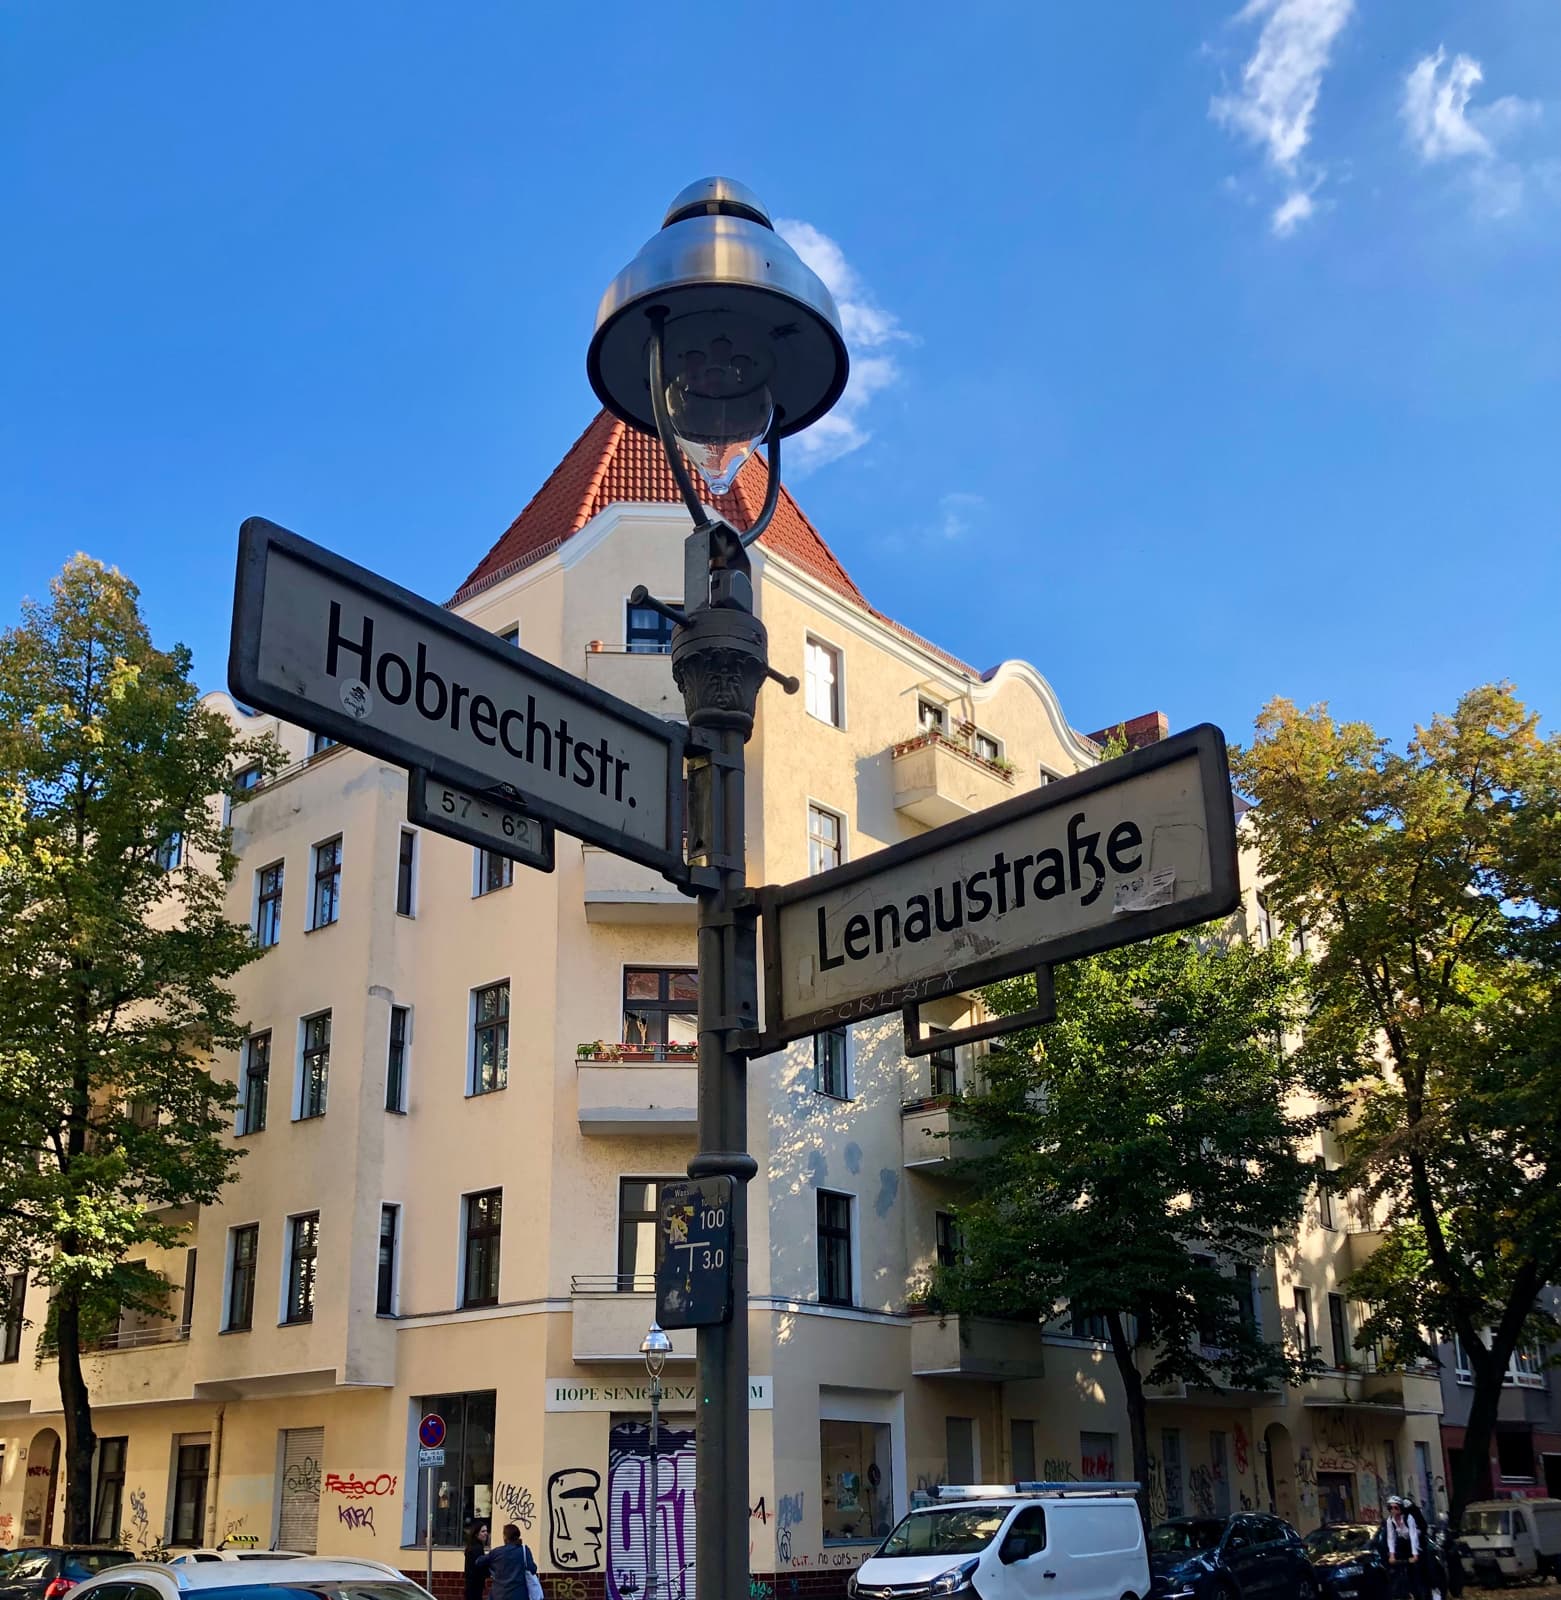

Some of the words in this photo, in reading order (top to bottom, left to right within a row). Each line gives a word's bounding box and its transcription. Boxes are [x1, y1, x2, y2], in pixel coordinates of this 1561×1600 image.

[325, 600, 638, 809] Hobrechtstr.
[441, 790, 473, 819] 57
[501, 814, 530, 845] 62
[817, 812, 1143, 972] Lenaustraße
[700, 1208, 725, 1230] 100
[702, 1248, 724, 1270] 3,0
[555, 1387, 600, 1401] HOPE
